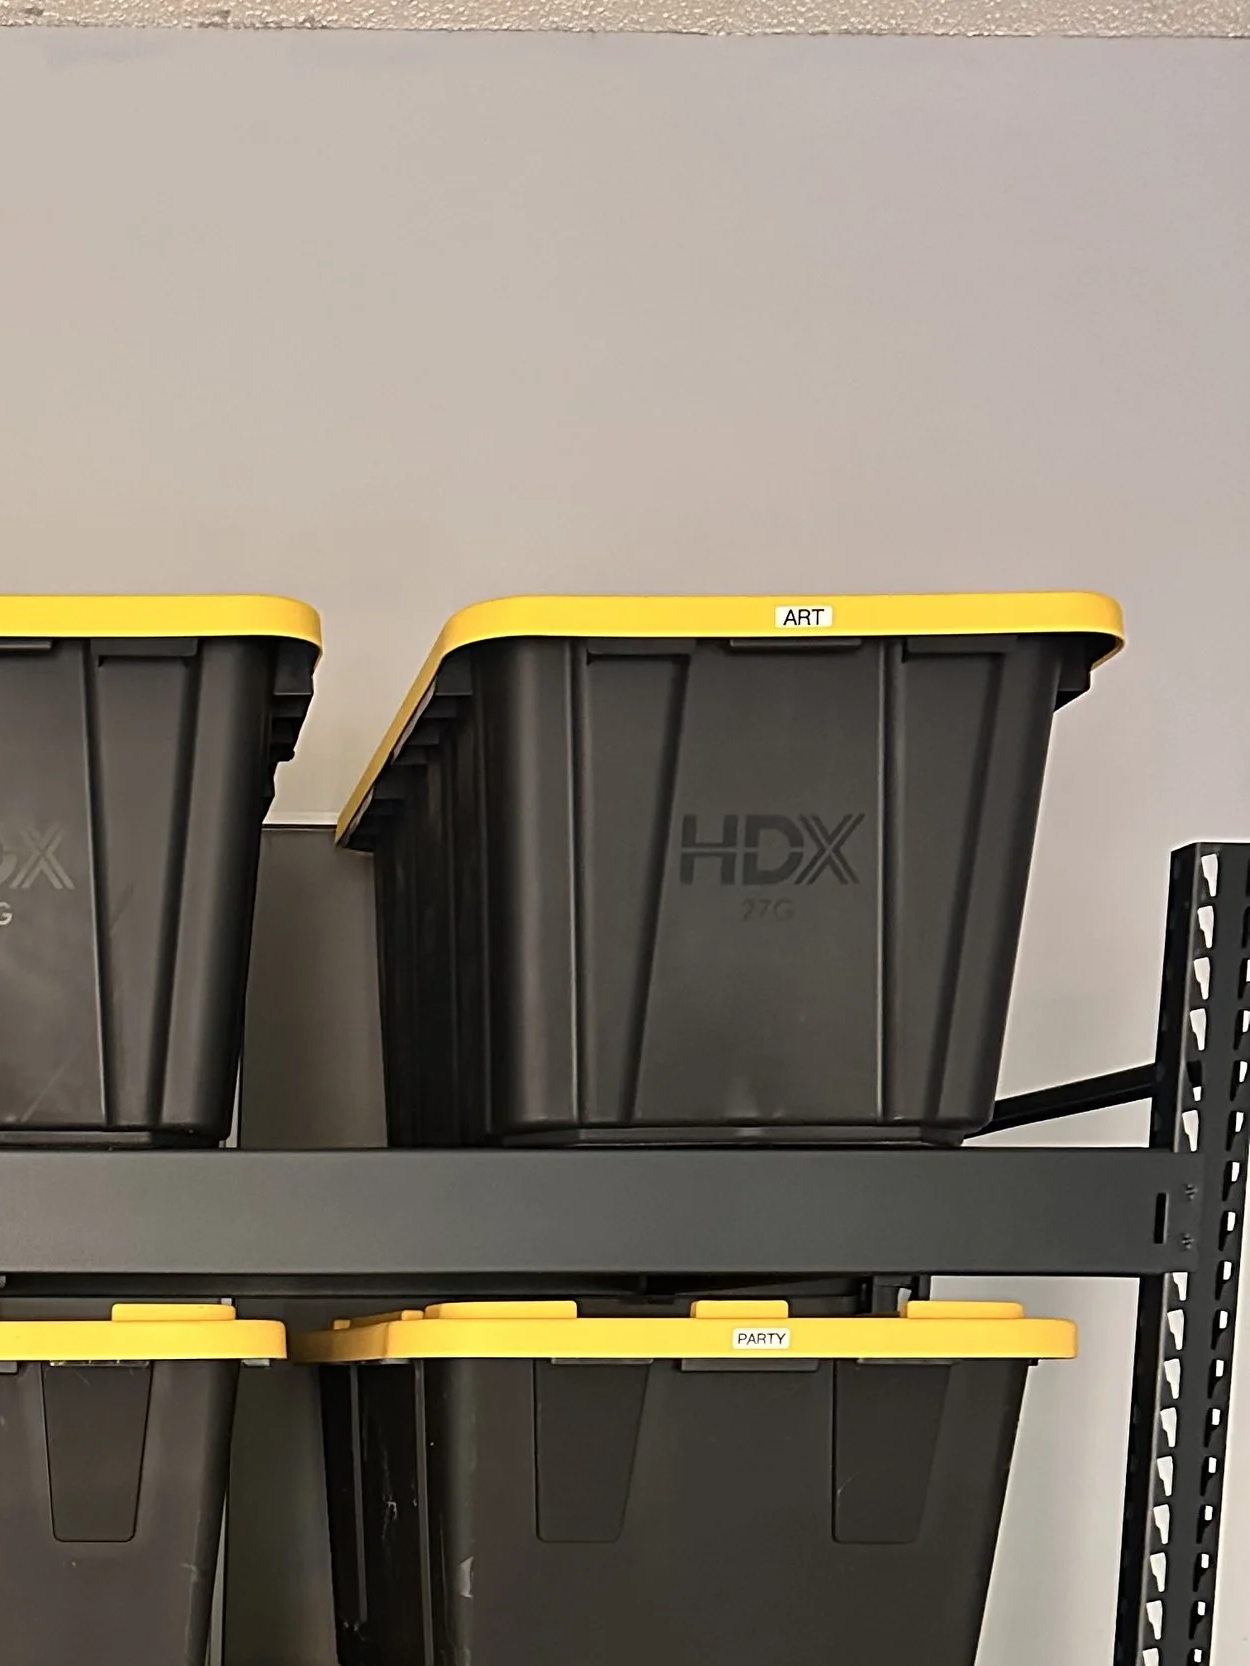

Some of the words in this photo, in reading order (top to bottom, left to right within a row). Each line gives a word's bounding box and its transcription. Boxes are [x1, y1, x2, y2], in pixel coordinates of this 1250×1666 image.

[783, 608, 825, 626] ART
[679, 814, 865, 886] HDX
[741, 898, 796, 922] 27G
[737, 1332, 786, 1345] PARTY
